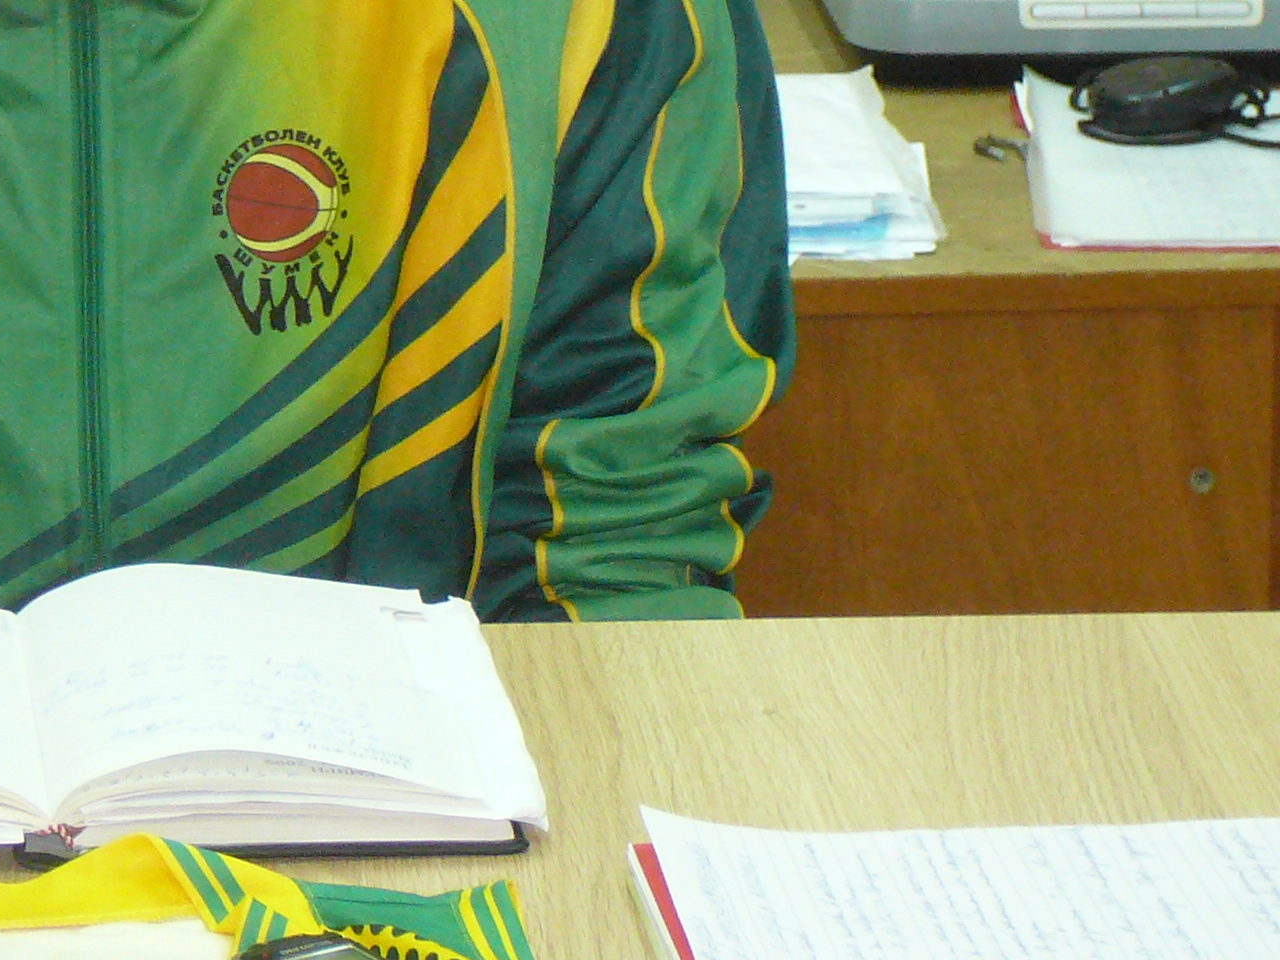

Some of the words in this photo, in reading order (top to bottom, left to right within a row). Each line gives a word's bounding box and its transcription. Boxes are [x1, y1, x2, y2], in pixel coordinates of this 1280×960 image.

[212, 128, 322, 217] БАСКЕТБОЛЕН
[322, 146, 351, 196] КЛУБ
[232, 231, 339, 275] ШУМЕН
